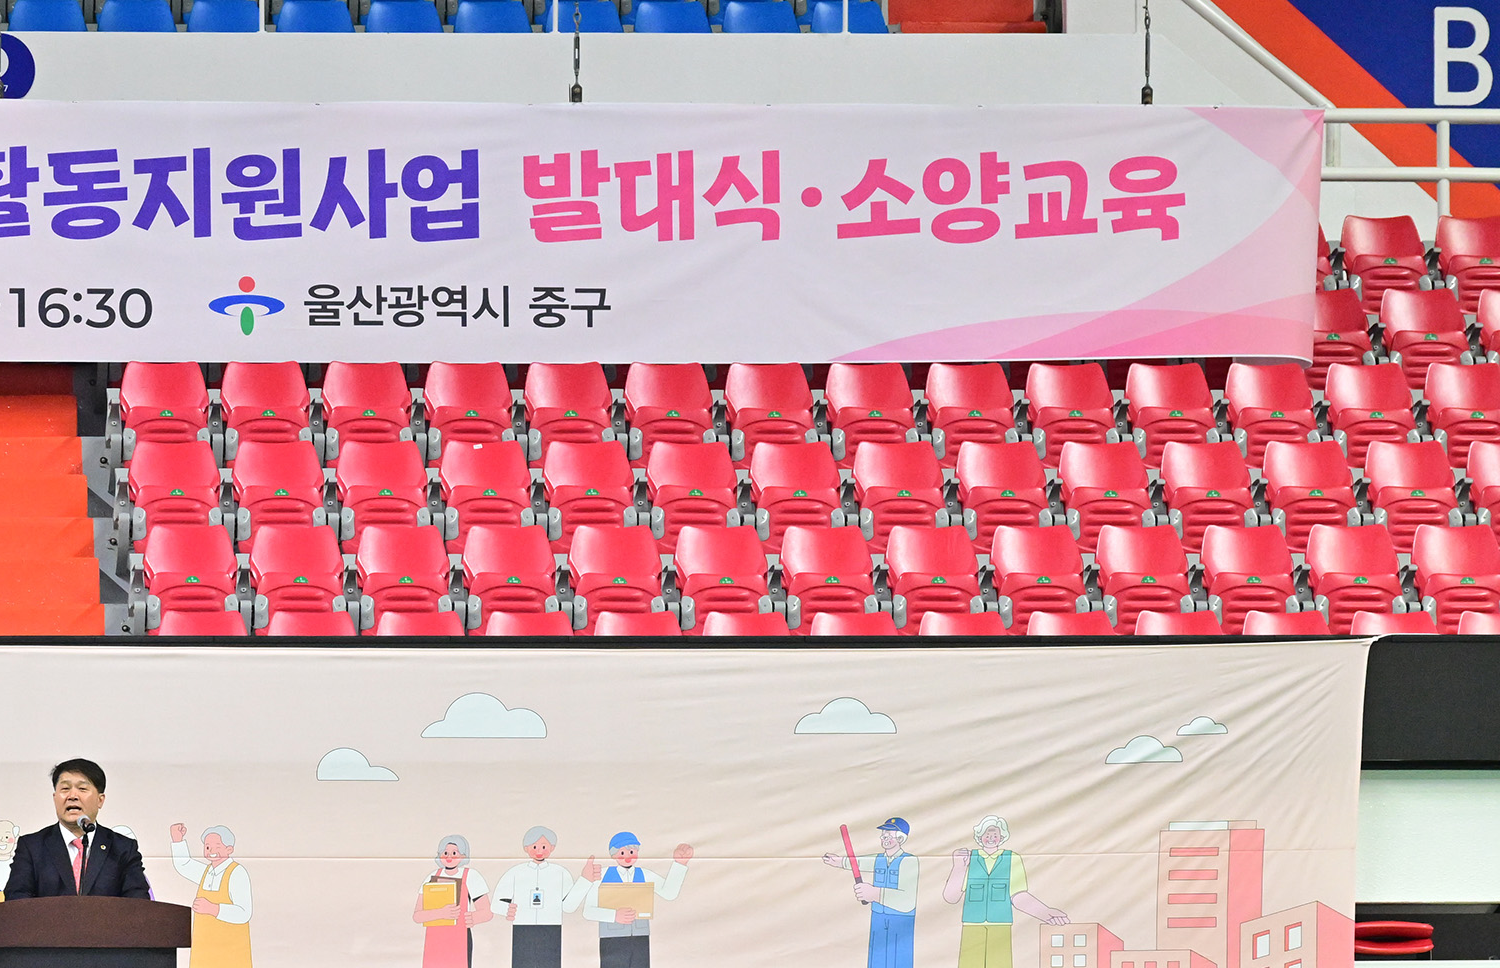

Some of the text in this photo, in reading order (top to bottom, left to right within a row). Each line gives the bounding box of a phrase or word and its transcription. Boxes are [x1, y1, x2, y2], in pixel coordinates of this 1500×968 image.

[1434, 6, 1493, 106] B
[523, 149, 1186, 244] 발대식·소양교육
[303, 284, 612, 329] 울산광역시 중구
